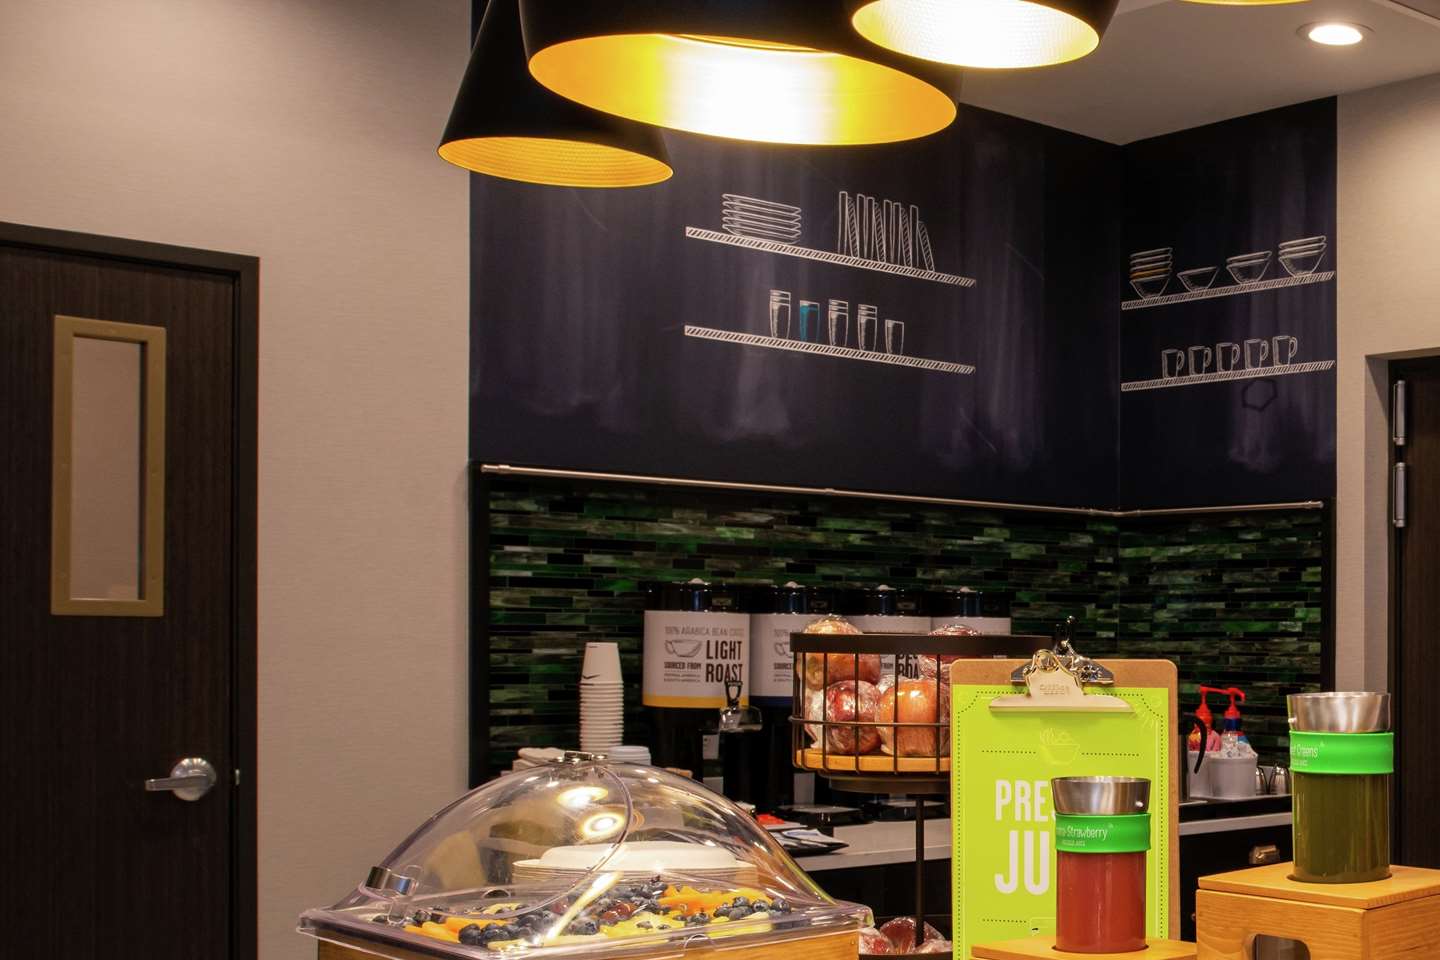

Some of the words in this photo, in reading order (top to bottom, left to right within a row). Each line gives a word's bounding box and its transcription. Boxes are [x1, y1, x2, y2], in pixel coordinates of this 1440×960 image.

[706, 640, 742, 660] LIGHT
[706, 663, 743, 683] ROAST
[995, 779, 1056, 822] PRE
